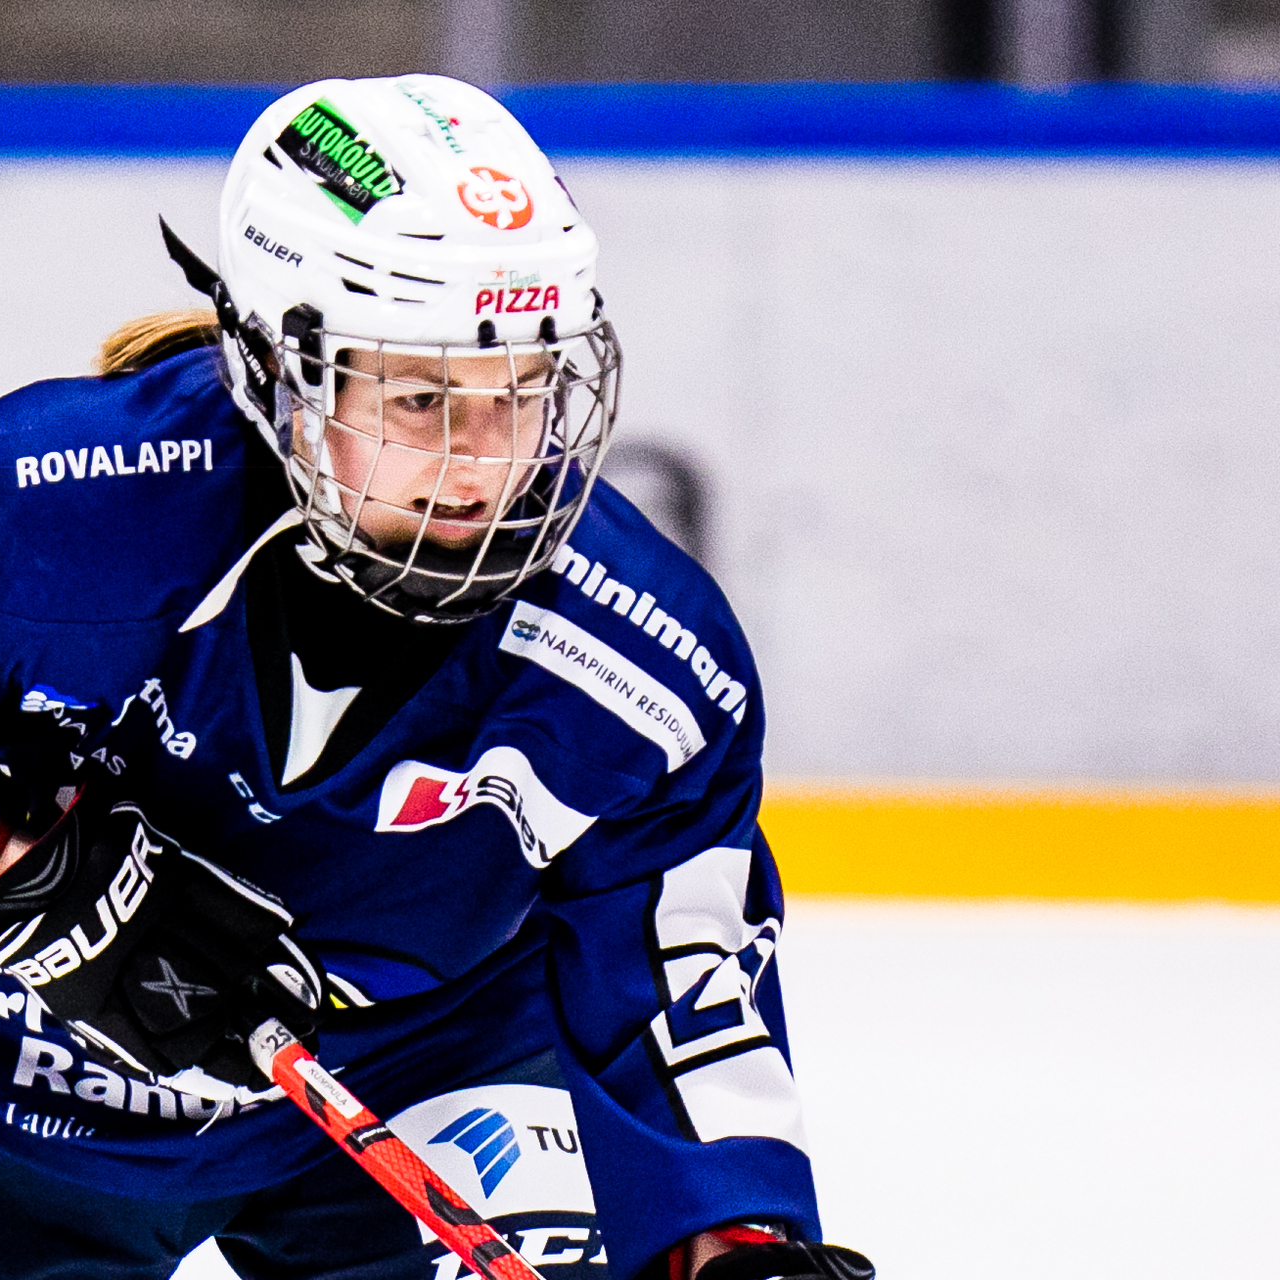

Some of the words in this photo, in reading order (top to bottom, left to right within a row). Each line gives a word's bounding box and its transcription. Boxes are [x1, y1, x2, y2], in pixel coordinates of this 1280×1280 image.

[475, 285, 559, 315] PIZZA
[16, 439, 213, 488] ROVALAPPI
[540, 630, 635, 699] NAPAPIIRIN
[11, 822, 162, 986] BAUER
